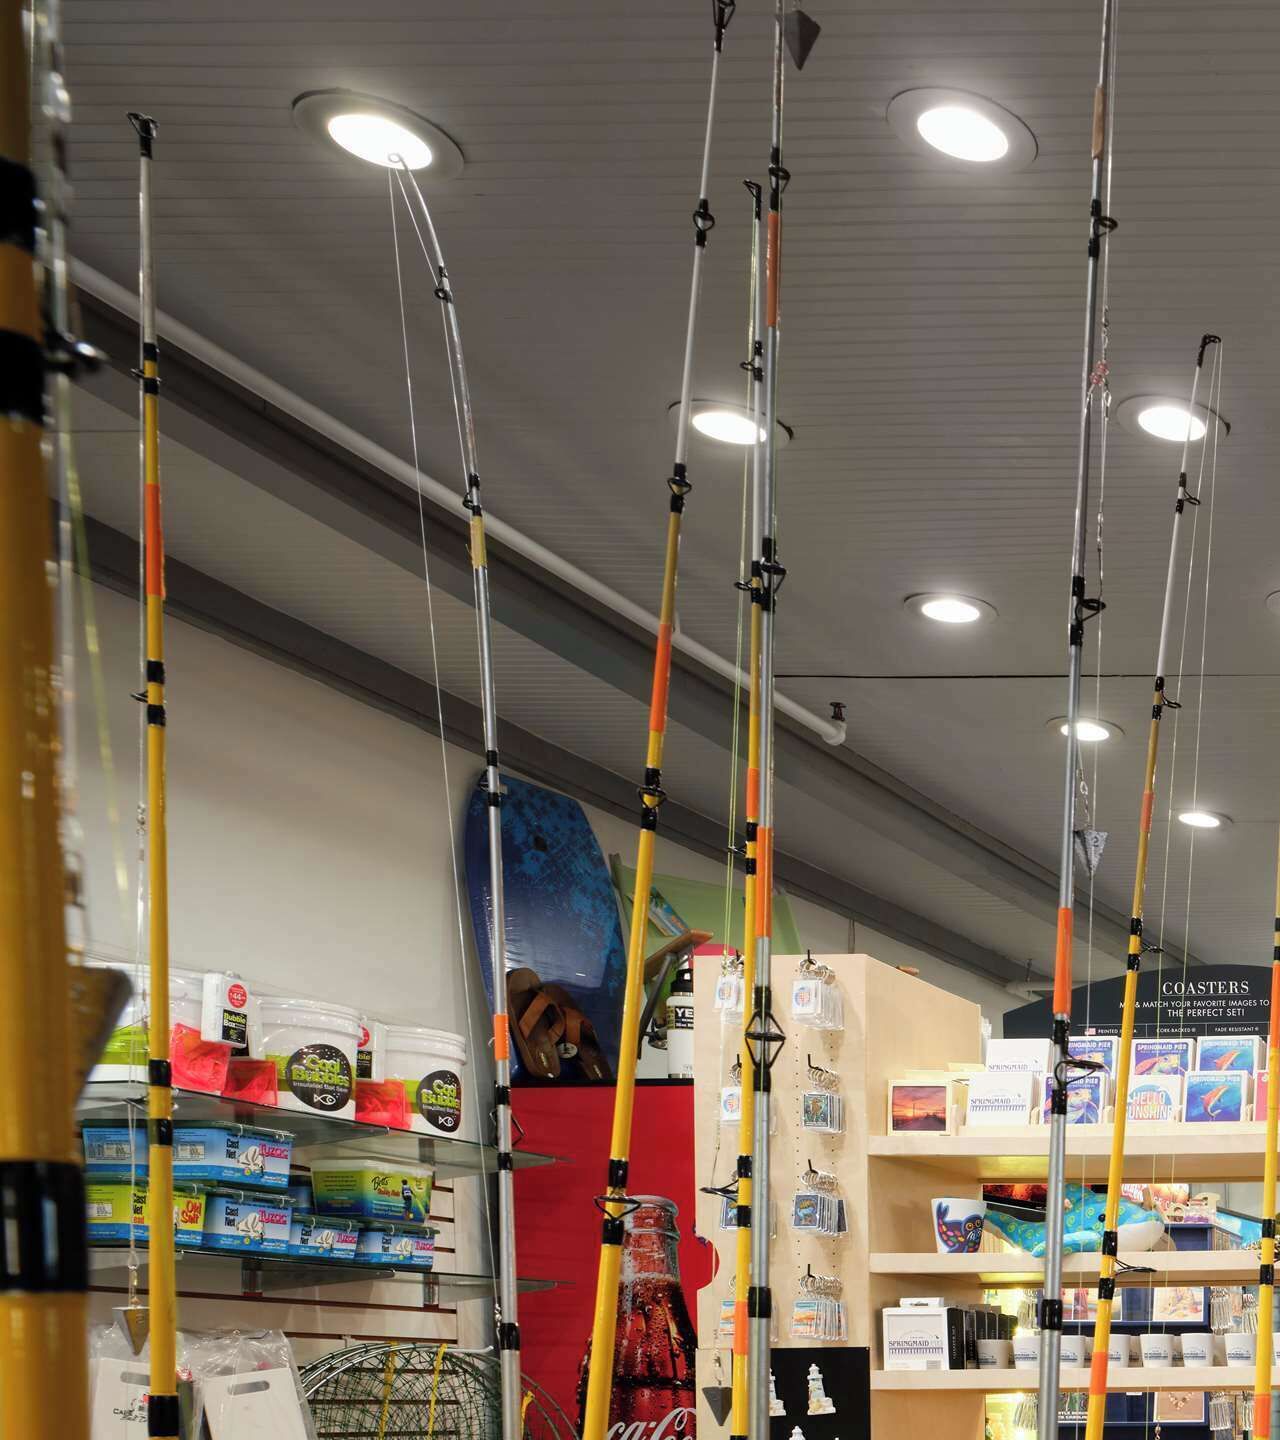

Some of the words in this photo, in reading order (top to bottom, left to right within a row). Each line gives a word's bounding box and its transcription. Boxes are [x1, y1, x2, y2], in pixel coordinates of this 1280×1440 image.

[1162, 980, 1250, 995] COASTERS
[1142, 1000, 1169, 1008] MATCH
[1171, 999, 1191, 1008] YOUR
[1193, 999, 1226, 1007] FAVORITE
[1229, 998, 1258, 1007] IMAGES
[1259, 998, 1270, 1006] TO
[223, 1012, 246, 1024] Bubble
[1167, 1008, 1184, 1017] THE
[1187, 1008, 1224, 1017] PERFECT
[223, 1019, 236, 1027] Box
[1098, 1041, 1111, 1049] PIER
[1137, 1042, 1172, 1050] SPRINGMAID
[305, 1054, 340, 1072] Cool
[291, 1065, 350, 1086] Bubbles
[1131, 1091, 1166, 1104] HELLO
[226, 1137, 240, 1149] Cast
[225, 1149, 237, 1159] Net
[225, 1205, 239, 1217] Cast
[224, 1216, 236, 1227] Net
